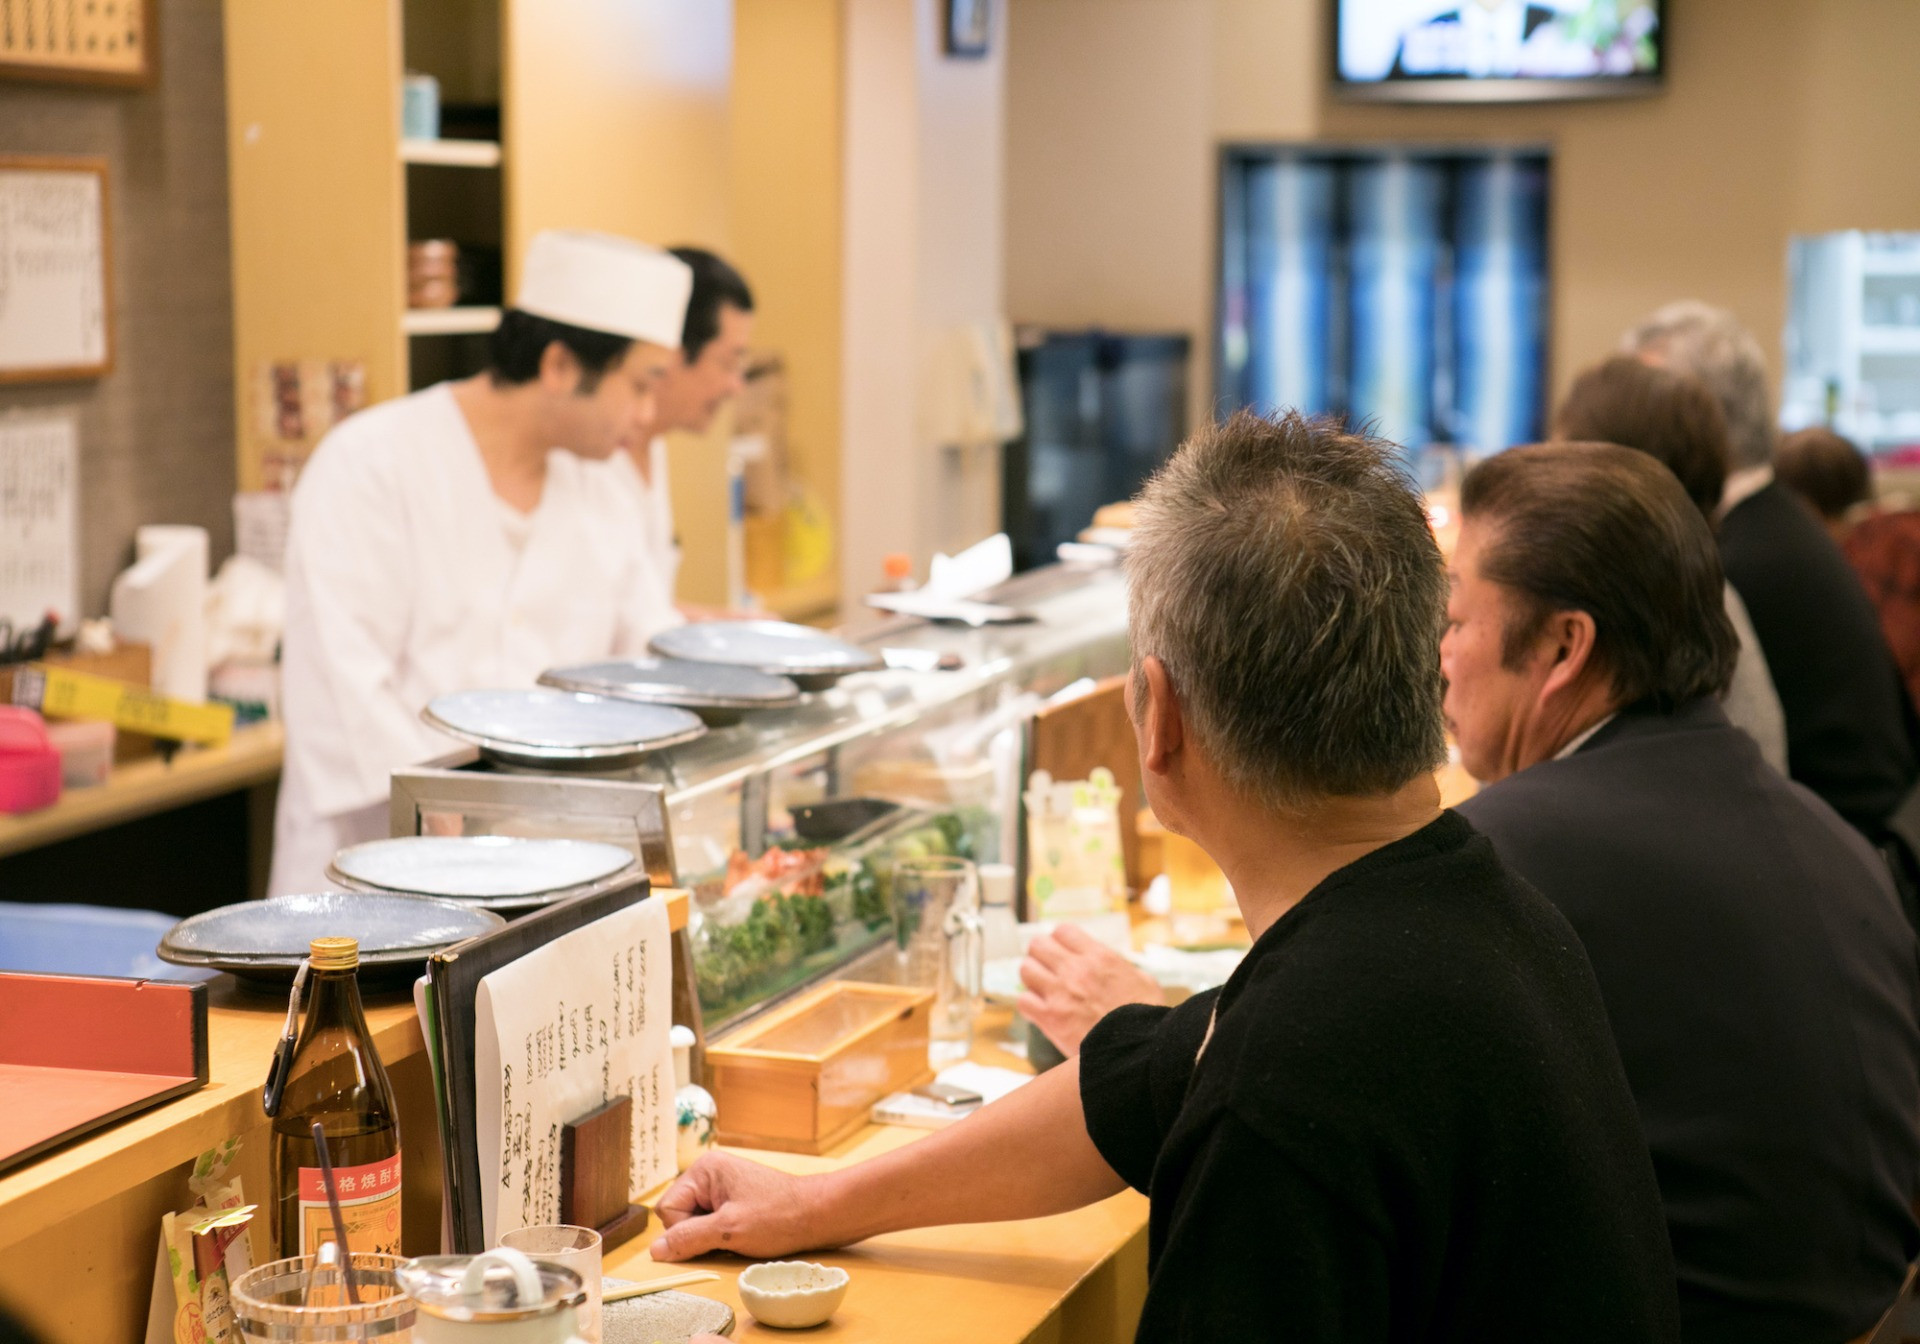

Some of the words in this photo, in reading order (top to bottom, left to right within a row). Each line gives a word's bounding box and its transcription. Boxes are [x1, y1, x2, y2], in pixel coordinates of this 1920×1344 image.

[501, 1063, 513, 1189] 本日のおすすめ
[220, 1193, 242, 1210] KIRIN
